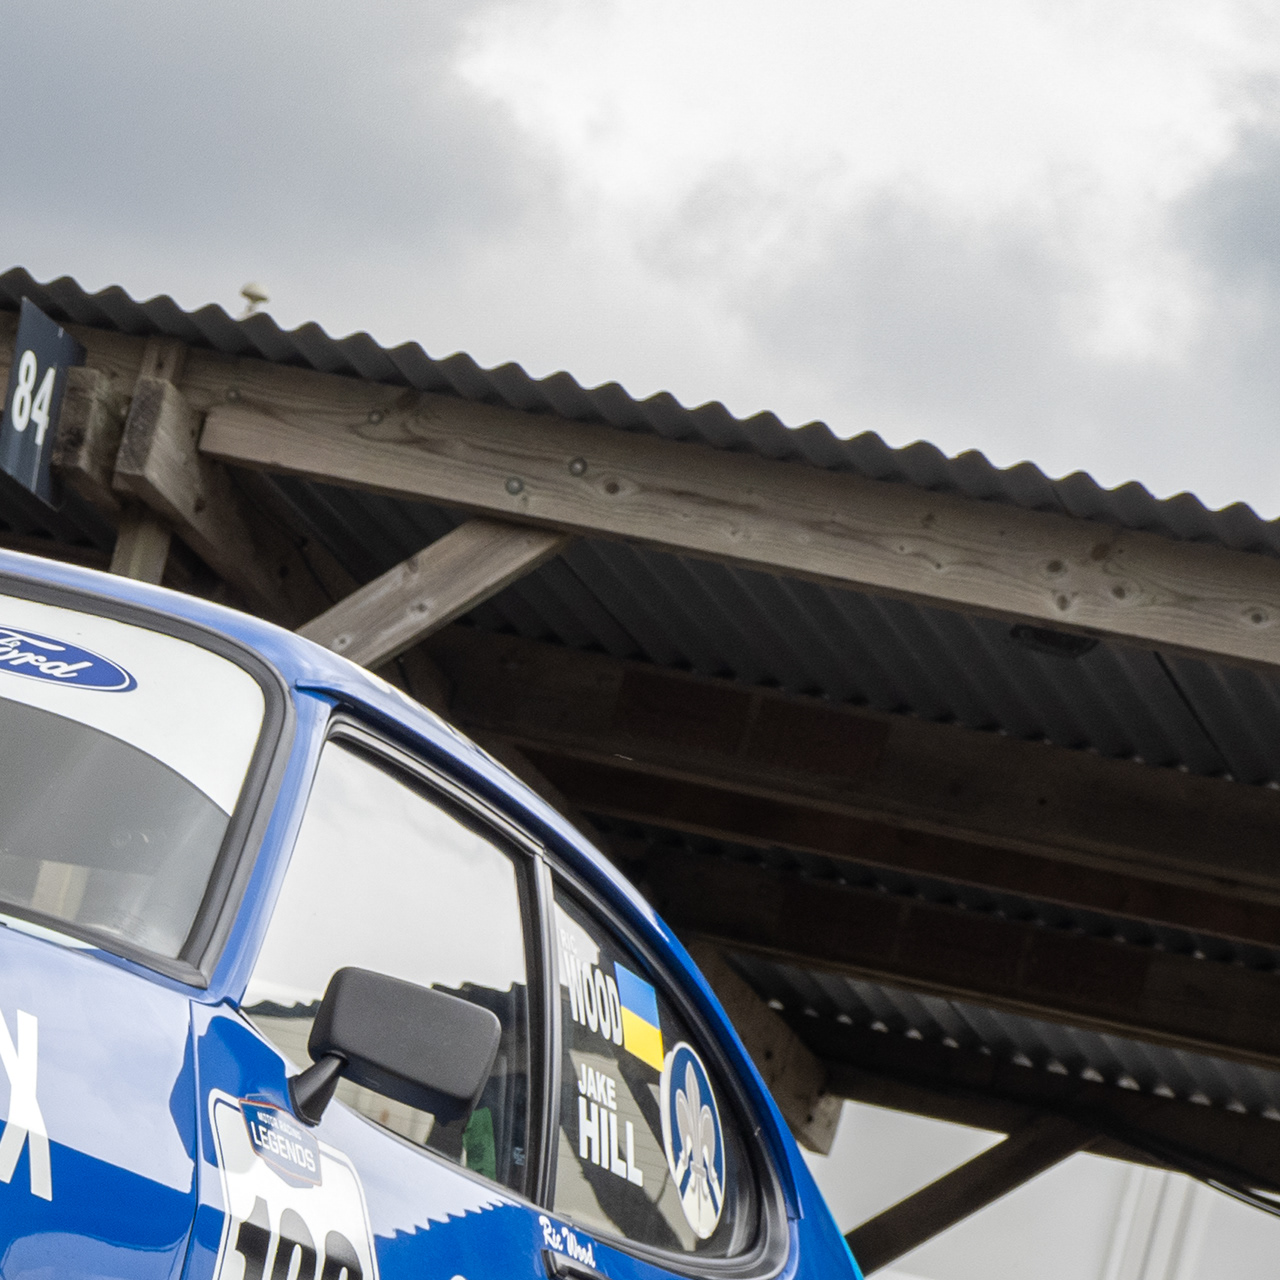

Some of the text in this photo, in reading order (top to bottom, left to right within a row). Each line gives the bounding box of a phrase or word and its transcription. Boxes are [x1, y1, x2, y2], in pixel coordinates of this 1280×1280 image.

[11, 350, 56, 445] 84
[562, 950, 624, 1046] WOOD
[578, 1063, 617, 1110] JAKE
[250, 1121, 317, 1173] LEGENDS
[578, 1096, 644, 1188] HILL
